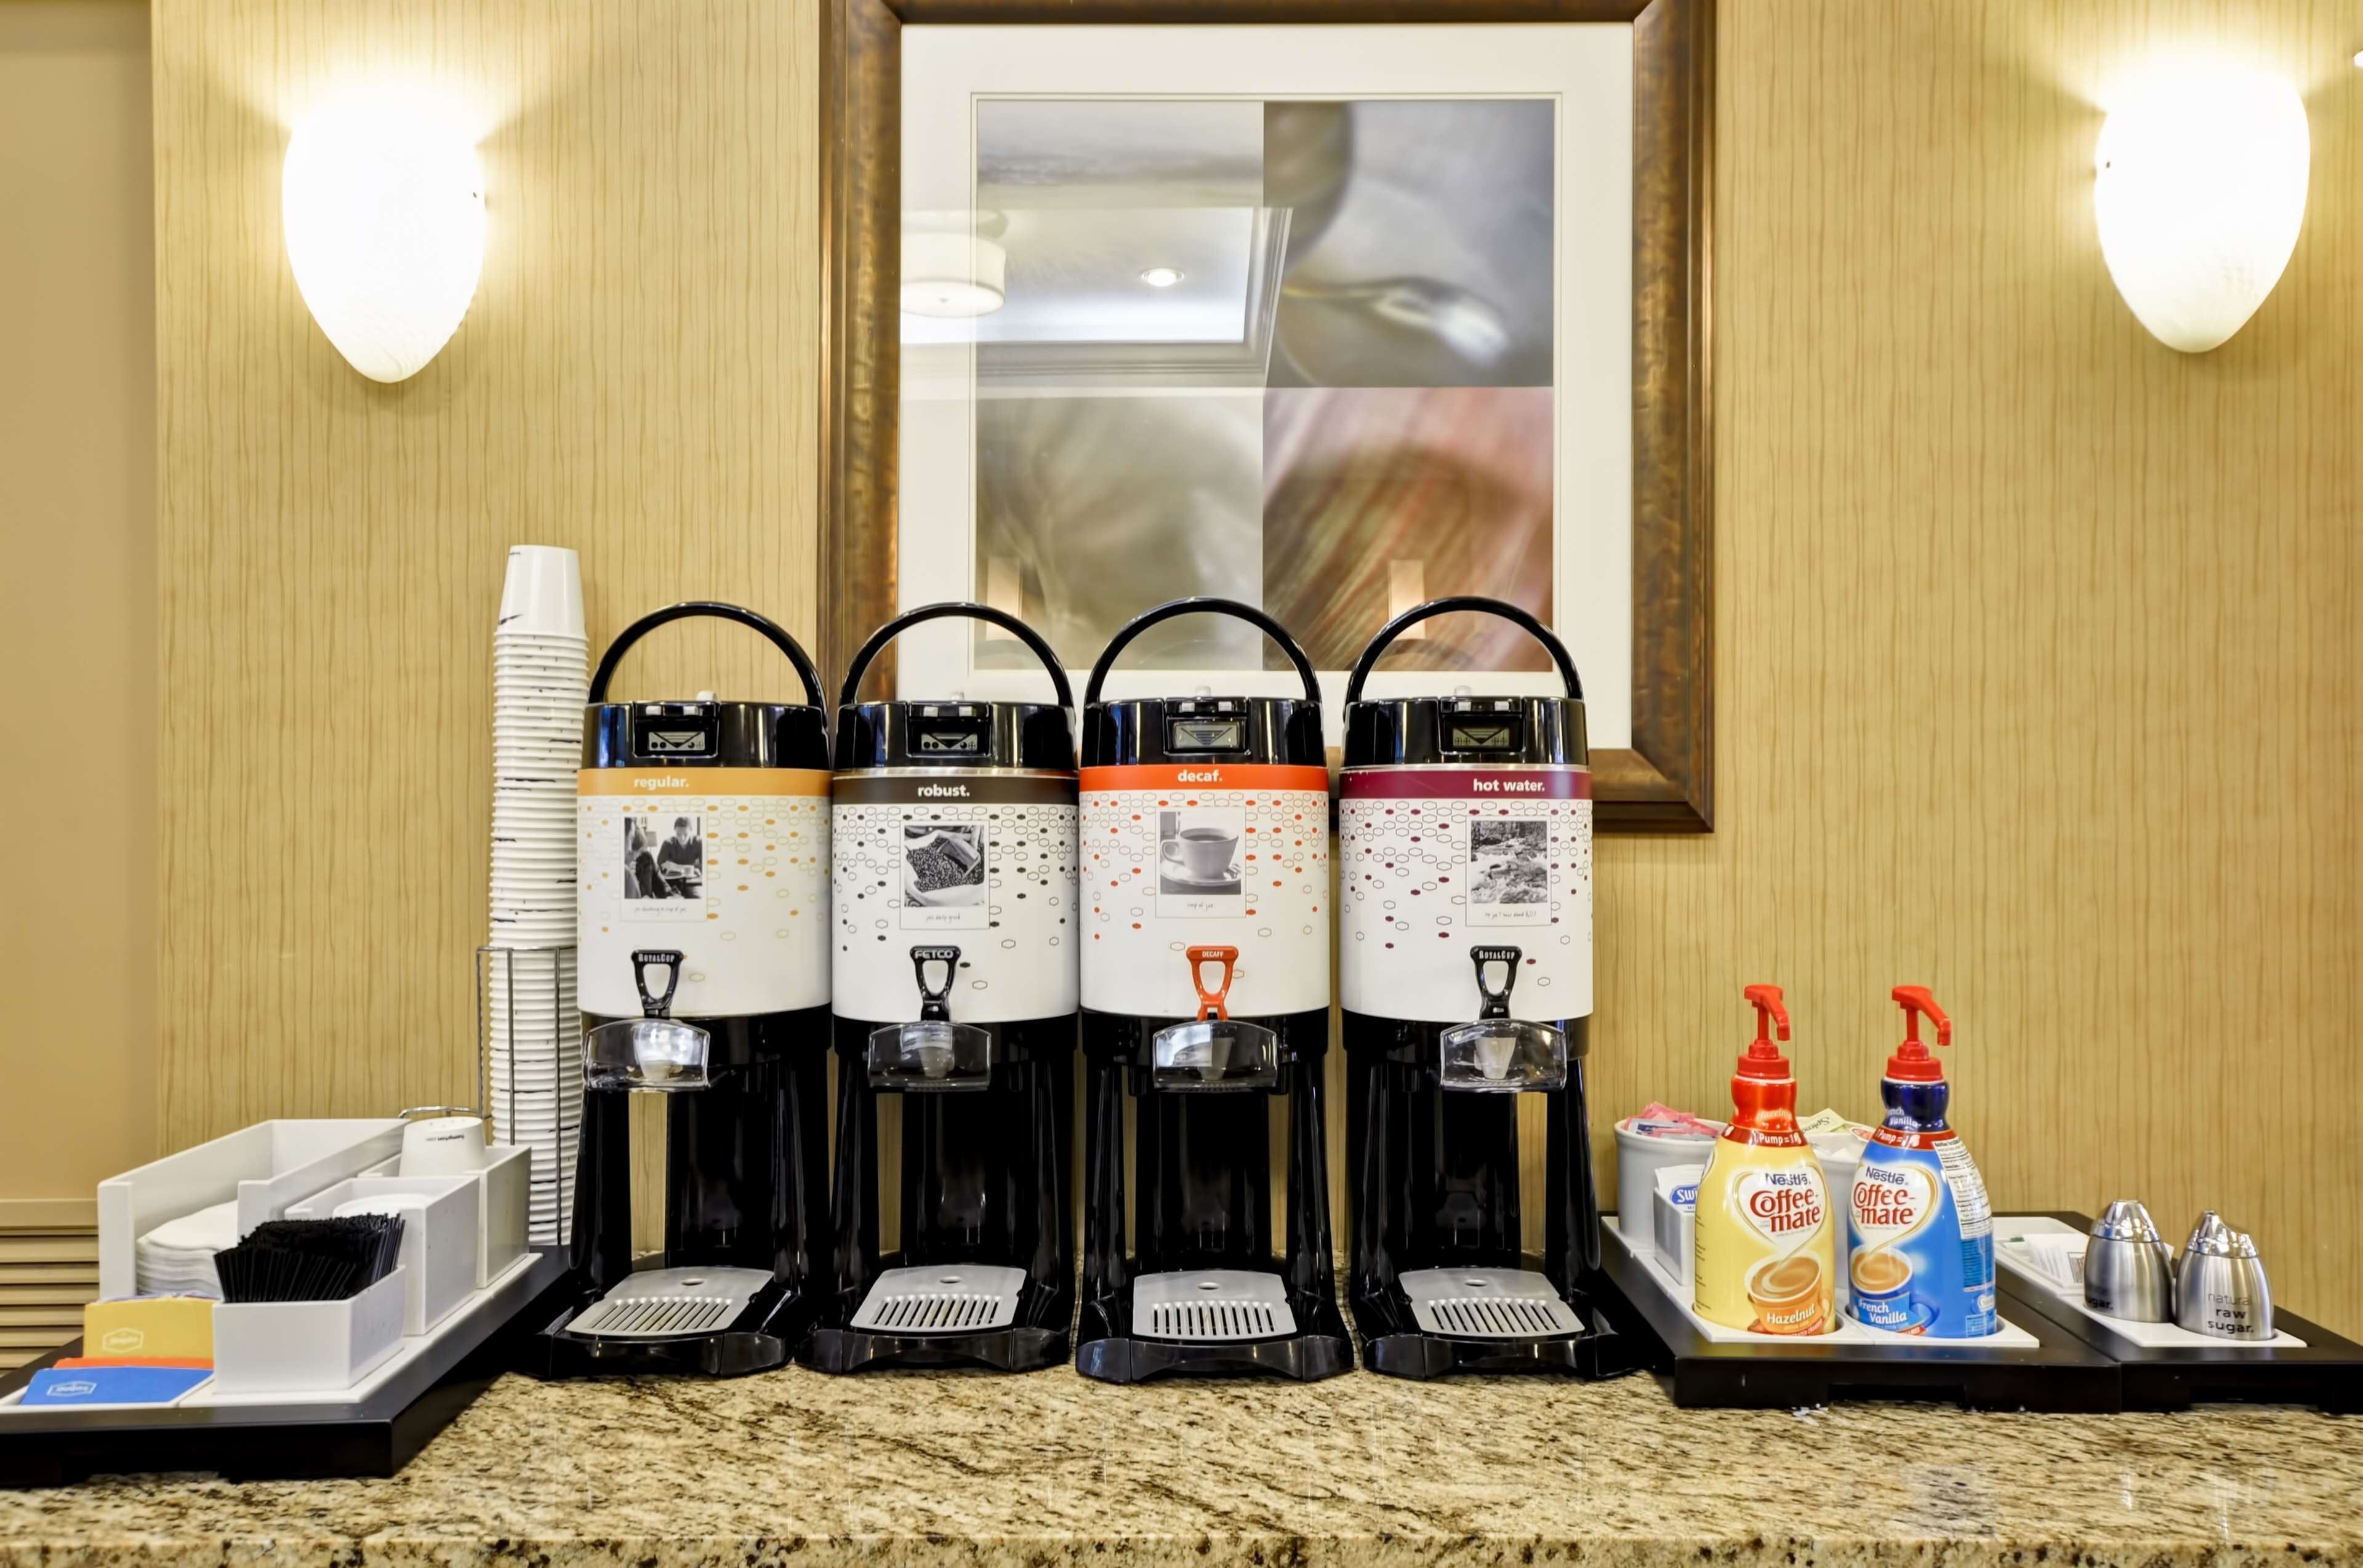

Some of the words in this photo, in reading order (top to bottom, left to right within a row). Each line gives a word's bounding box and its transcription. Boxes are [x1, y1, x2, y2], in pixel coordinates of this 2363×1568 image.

[1177, 769, 1223, 782] decaf.
[634, 775, 690, 791] regular.
[917, 783, 971, 797] robust.
[1473, 778, 1499, 792] hot
[1502, 780, 1545, 792] water.
[915, 950, 954, 959] FETCO
[1759, 1132, 1783, 1146] Pump
[1770, 1205, 1821, 1233] mate
[1861, 1207, 1914, 1225] mate
[1859, 1298, 1890, 1313] French
[2207, 1293, 2253, 1306] natural
[1767, 1303, 1815, 1325] Hazelnut
[1869, 1311, 1908, 1325] Vanilla
[2216, 1308, 2247, 1319] raw
[2207, 1320, 2255, 1335] sugar.
